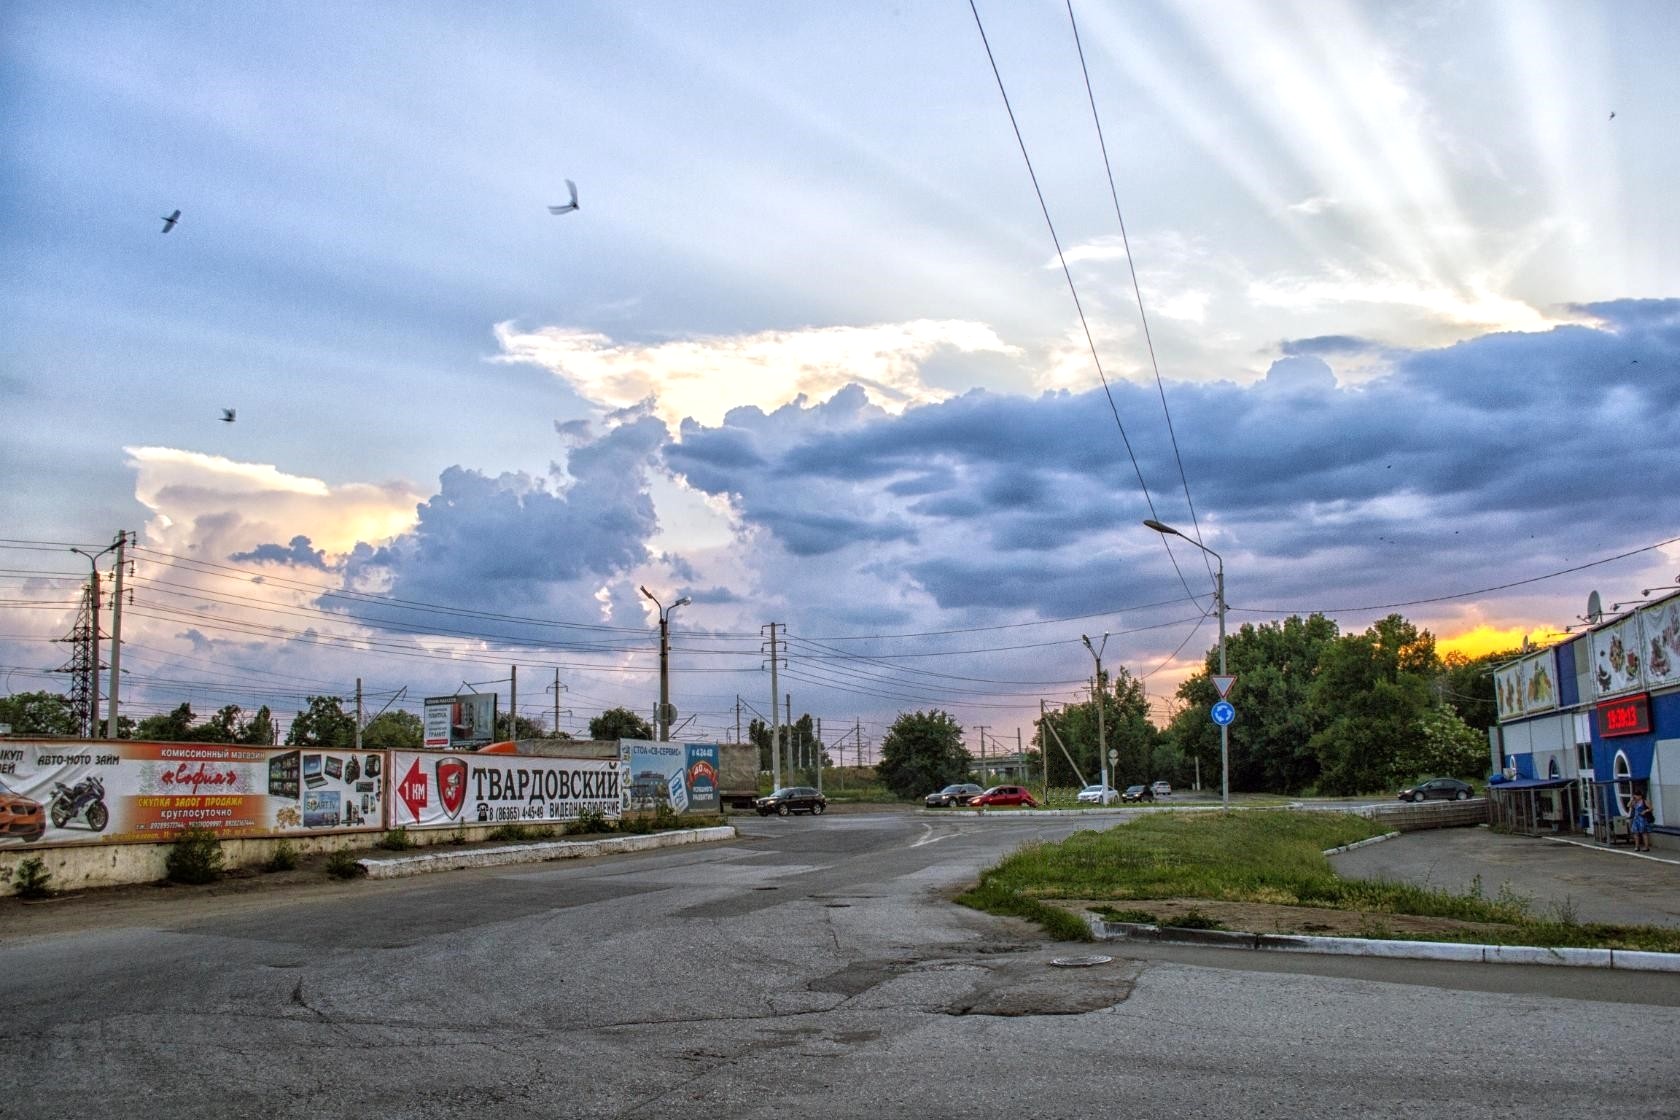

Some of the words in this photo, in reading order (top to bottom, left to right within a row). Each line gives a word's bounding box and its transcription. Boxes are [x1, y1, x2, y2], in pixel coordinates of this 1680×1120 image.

[38, 755, 91, 766] АВТО-МОТО
[95, 754, 120, 766] ЗАЙМ
[0, 763, 16, 774] ЕЙ
[472, 761, 620, 805] ТВАРДОВСКИЙ
[404, 781, 410, 800] 1
[138, 797, 171, 807] СКУПКА
[175, 797, 201, 807] ЗАЛОГ
[205, 797, 243, 807] ПРОДАЖА
[489, 807, 494, 821] 8
[495, 806, 520, 822] (86365)
